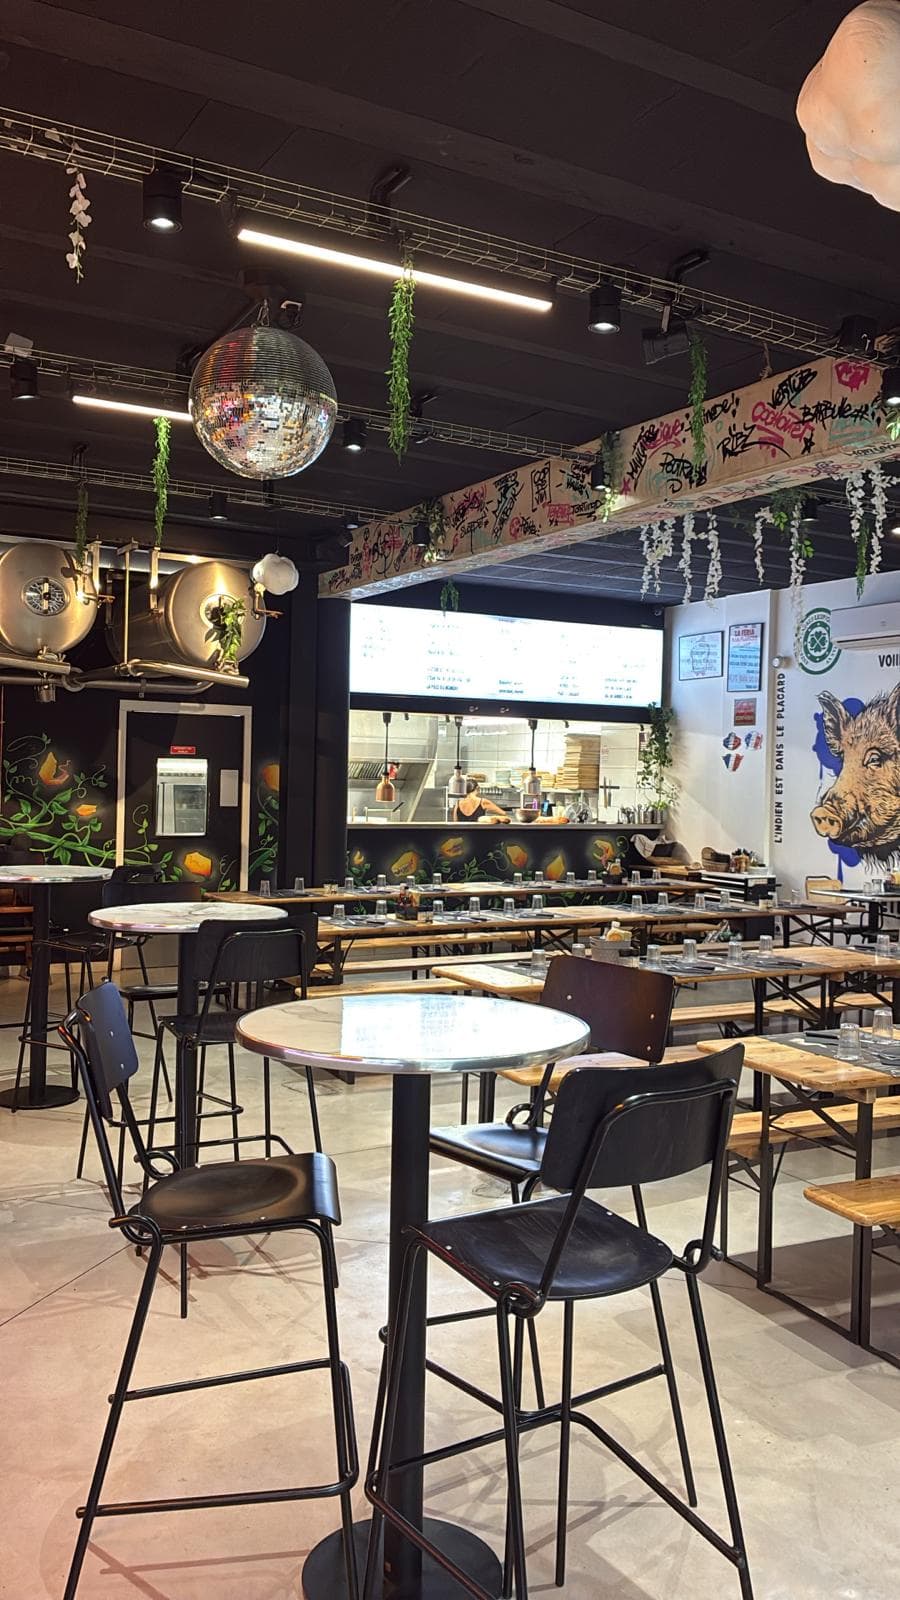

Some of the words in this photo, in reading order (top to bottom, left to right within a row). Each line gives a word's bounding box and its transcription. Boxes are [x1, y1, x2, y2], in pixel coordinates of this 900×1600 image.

[777, 672, 785, 720] PLACARD
[776, 726, 784, 743] LE
[776, 744, 784, 771] DANS
[775, 777, 783, 795] EST
[775, 801, 783, 844] L'INDIEN
